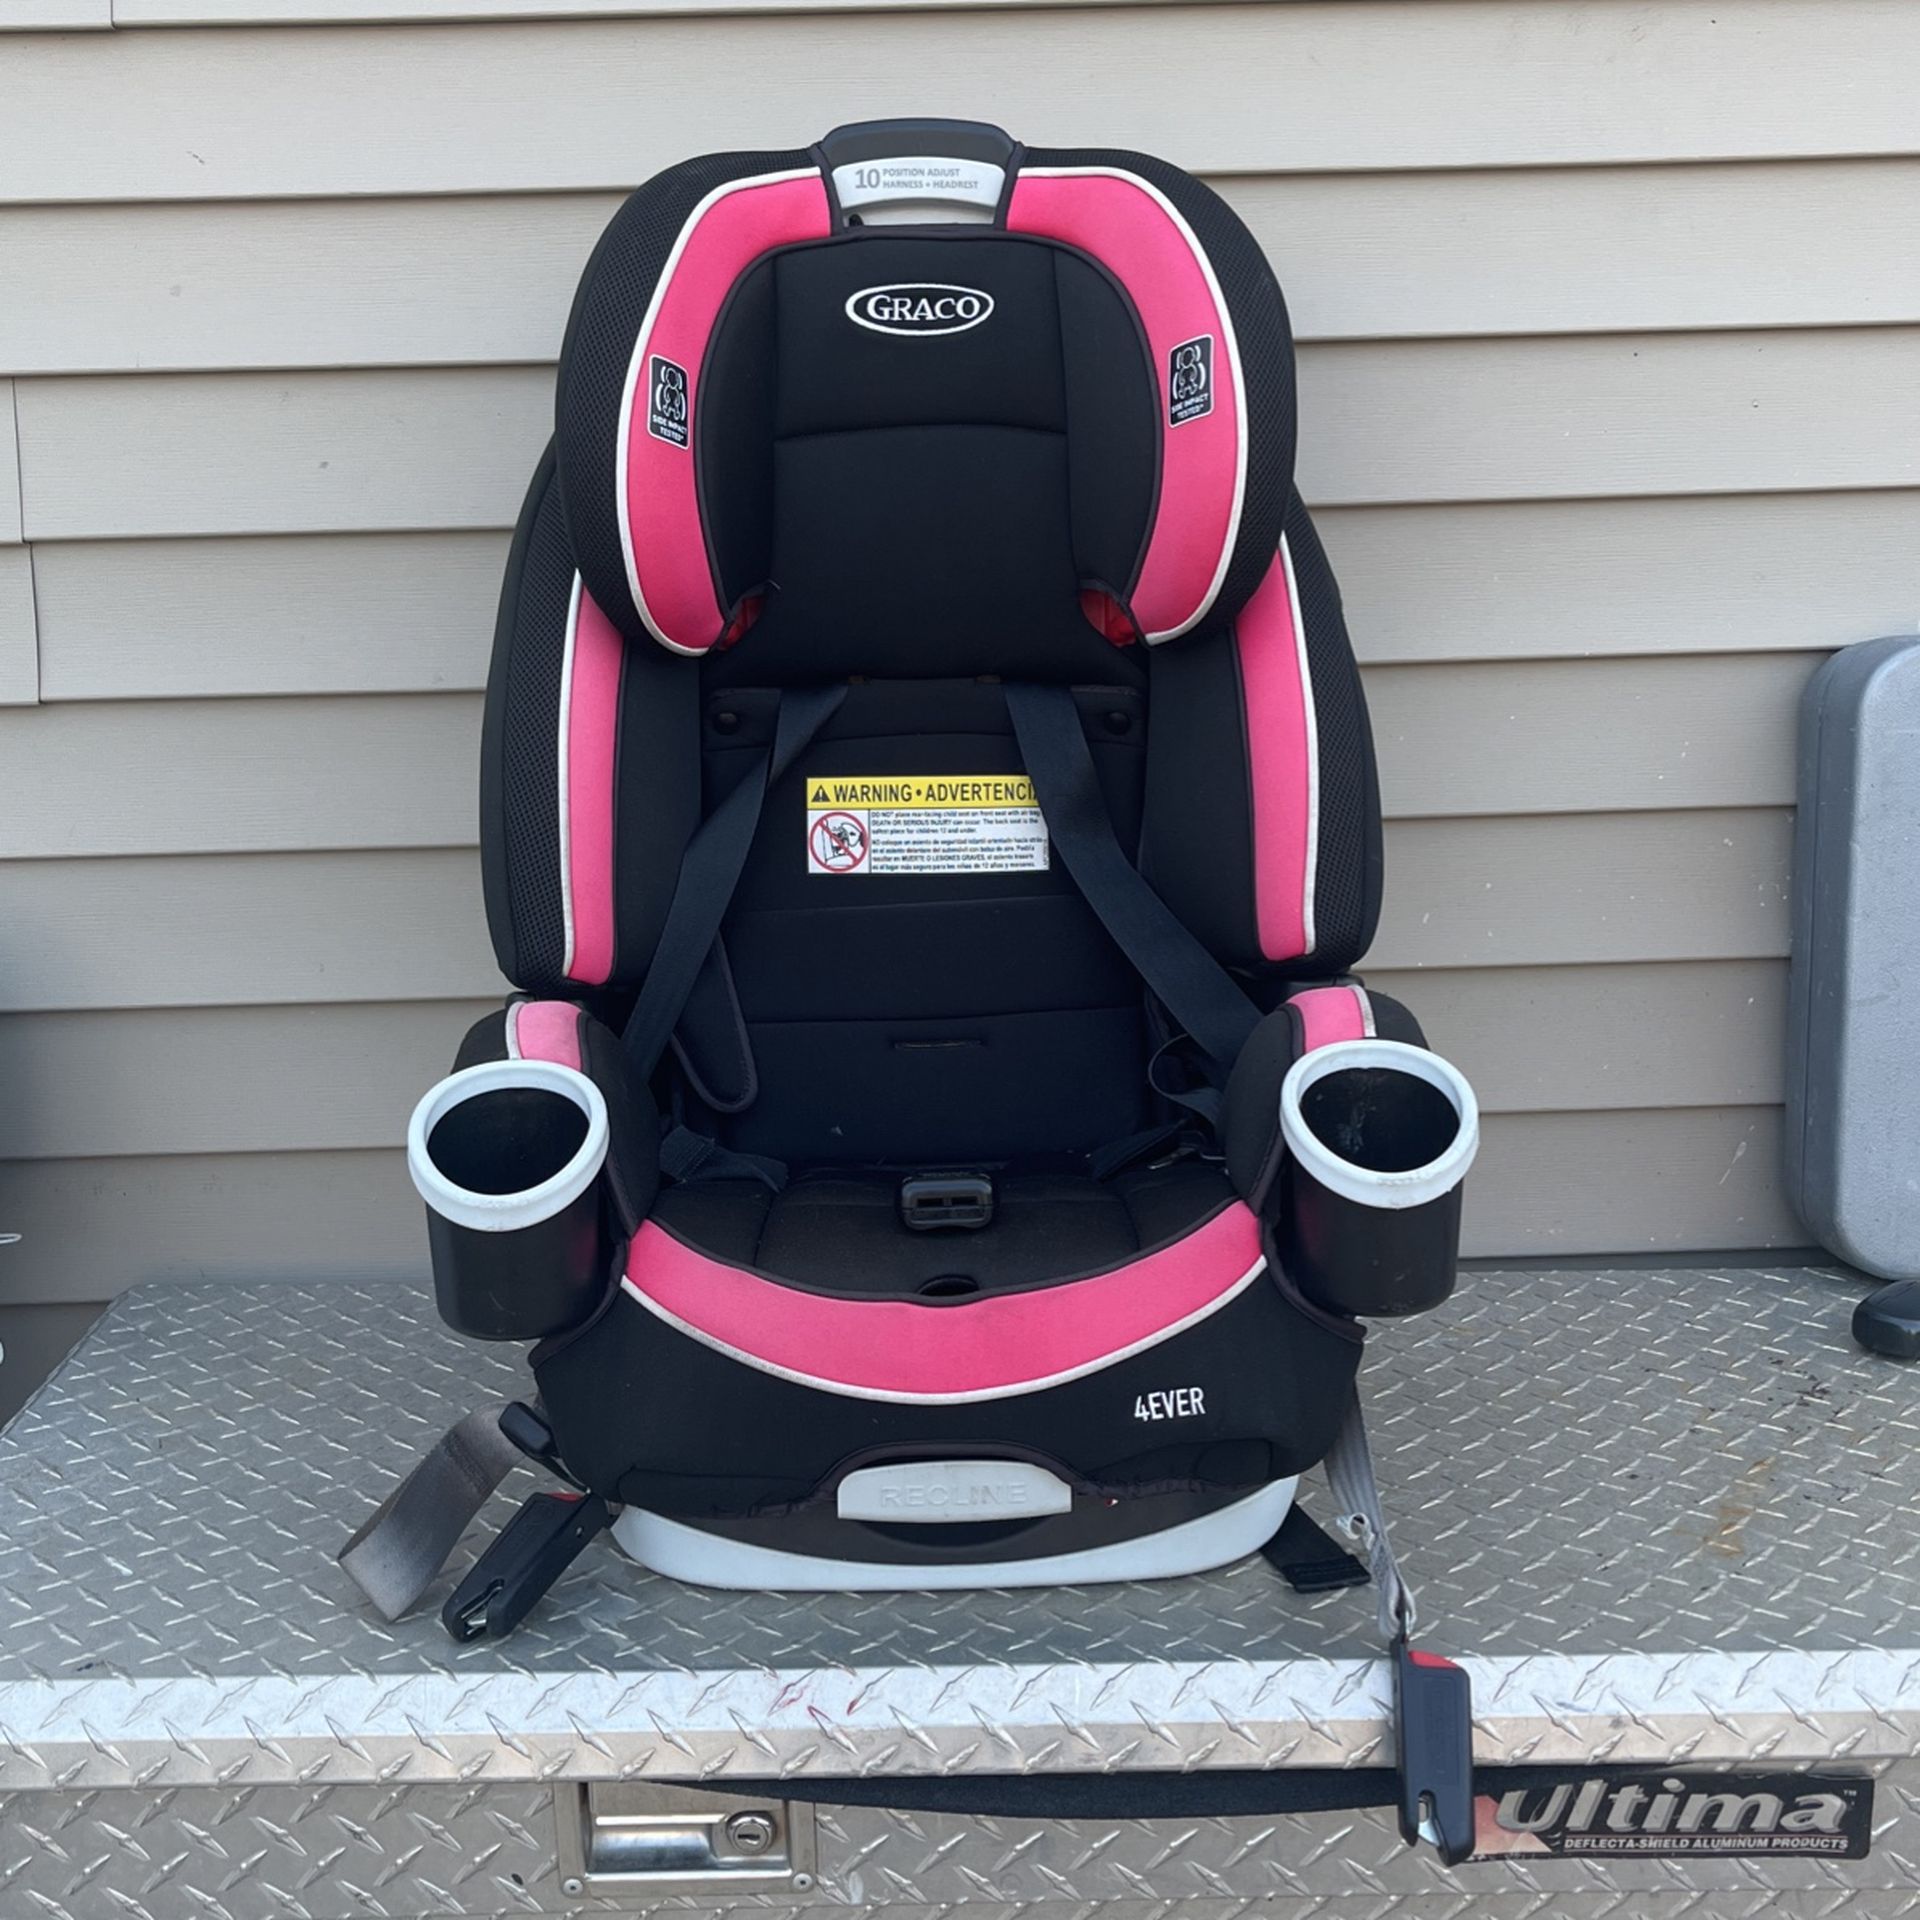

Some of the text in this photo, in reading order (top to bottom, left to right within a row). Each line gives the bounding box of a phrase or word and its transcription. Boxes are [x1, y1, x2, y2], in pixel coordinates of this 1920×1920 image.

[855, 168, 960, 189] 10 POSITION ADJUST
[883, 180, 923, 189] HARNESS
[932, 180, 979, 189] HEADREST
[867, 295, 980, 321] GRACO
[834, 784, 912, 802] WARNING
[1134, 1387, 1206, 1422] 4EVER
[880, 1482, 1027, 1508] RECLINE
[1564, 1838, 1849, 1849] DEFLECTA-SHIELD ALUMINUM PRODUCTS
